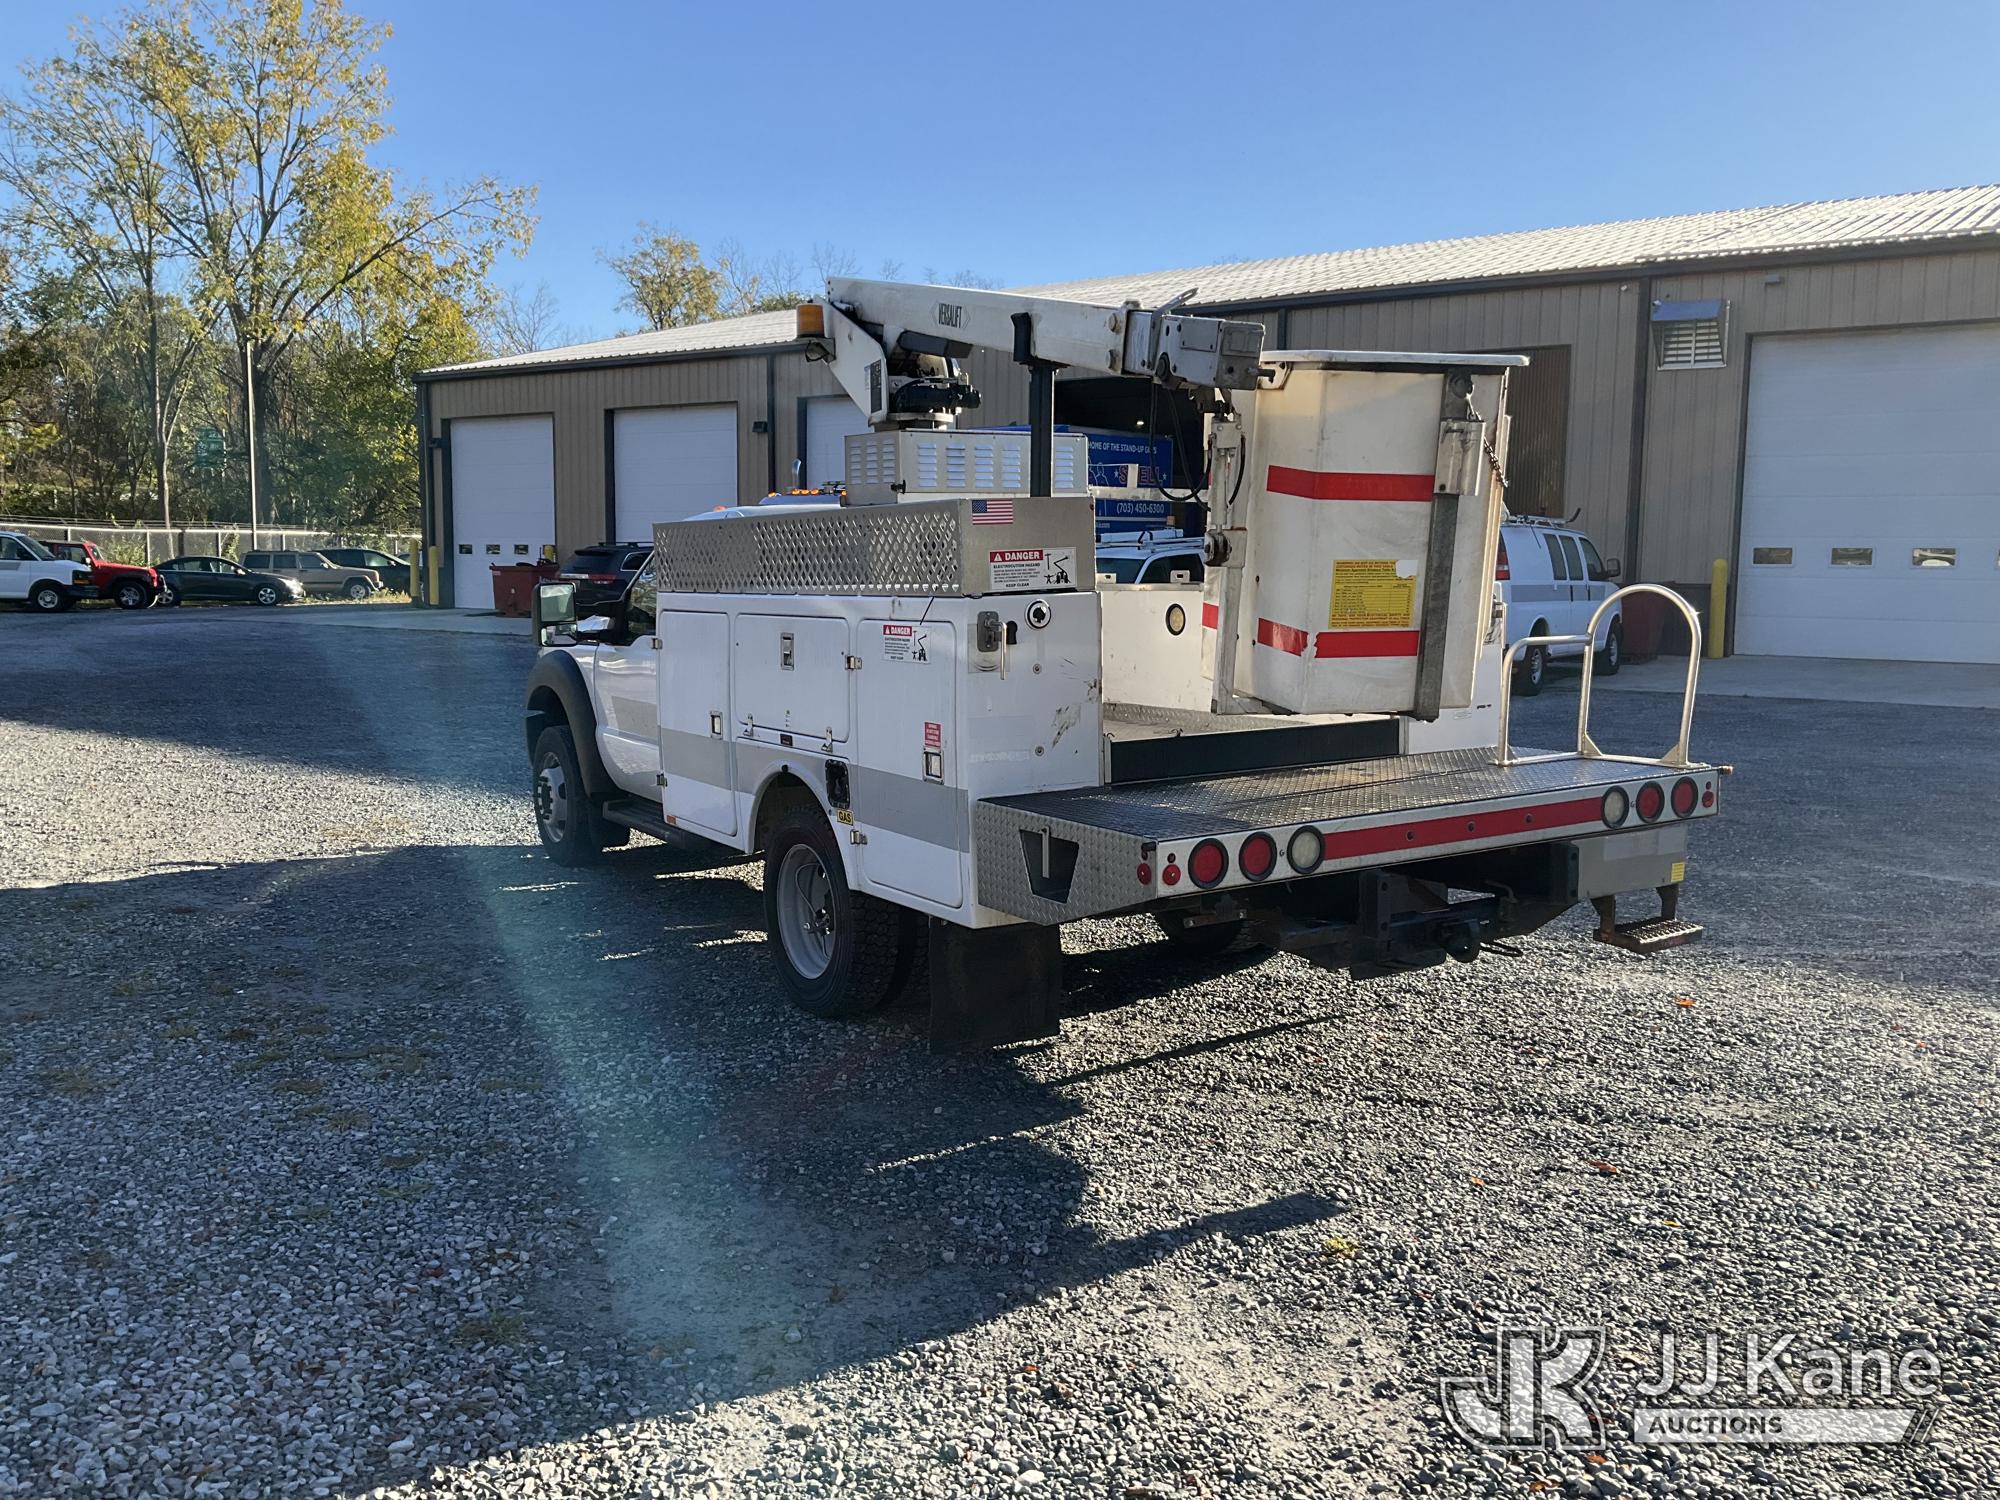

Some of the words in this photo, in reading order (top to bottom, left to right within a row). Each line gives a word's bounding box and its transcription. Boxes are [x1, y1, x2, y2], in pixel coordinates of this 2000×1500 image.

[1103, 442, 1109, 451] OF
[1110, 442, 1120, 451] THE
[1121, 443, 1144, 453] STAND-UP
[1119, 465, 1163, 487] SELL
[1117, 502, 1133, 514] (703)
[1134, 503, 1164, 514] 450-6300
[1004, 551, 1040, 561] DANGER
[890, 626, 911, 635] DANGER
[838, 811, 851, 823] GAS
